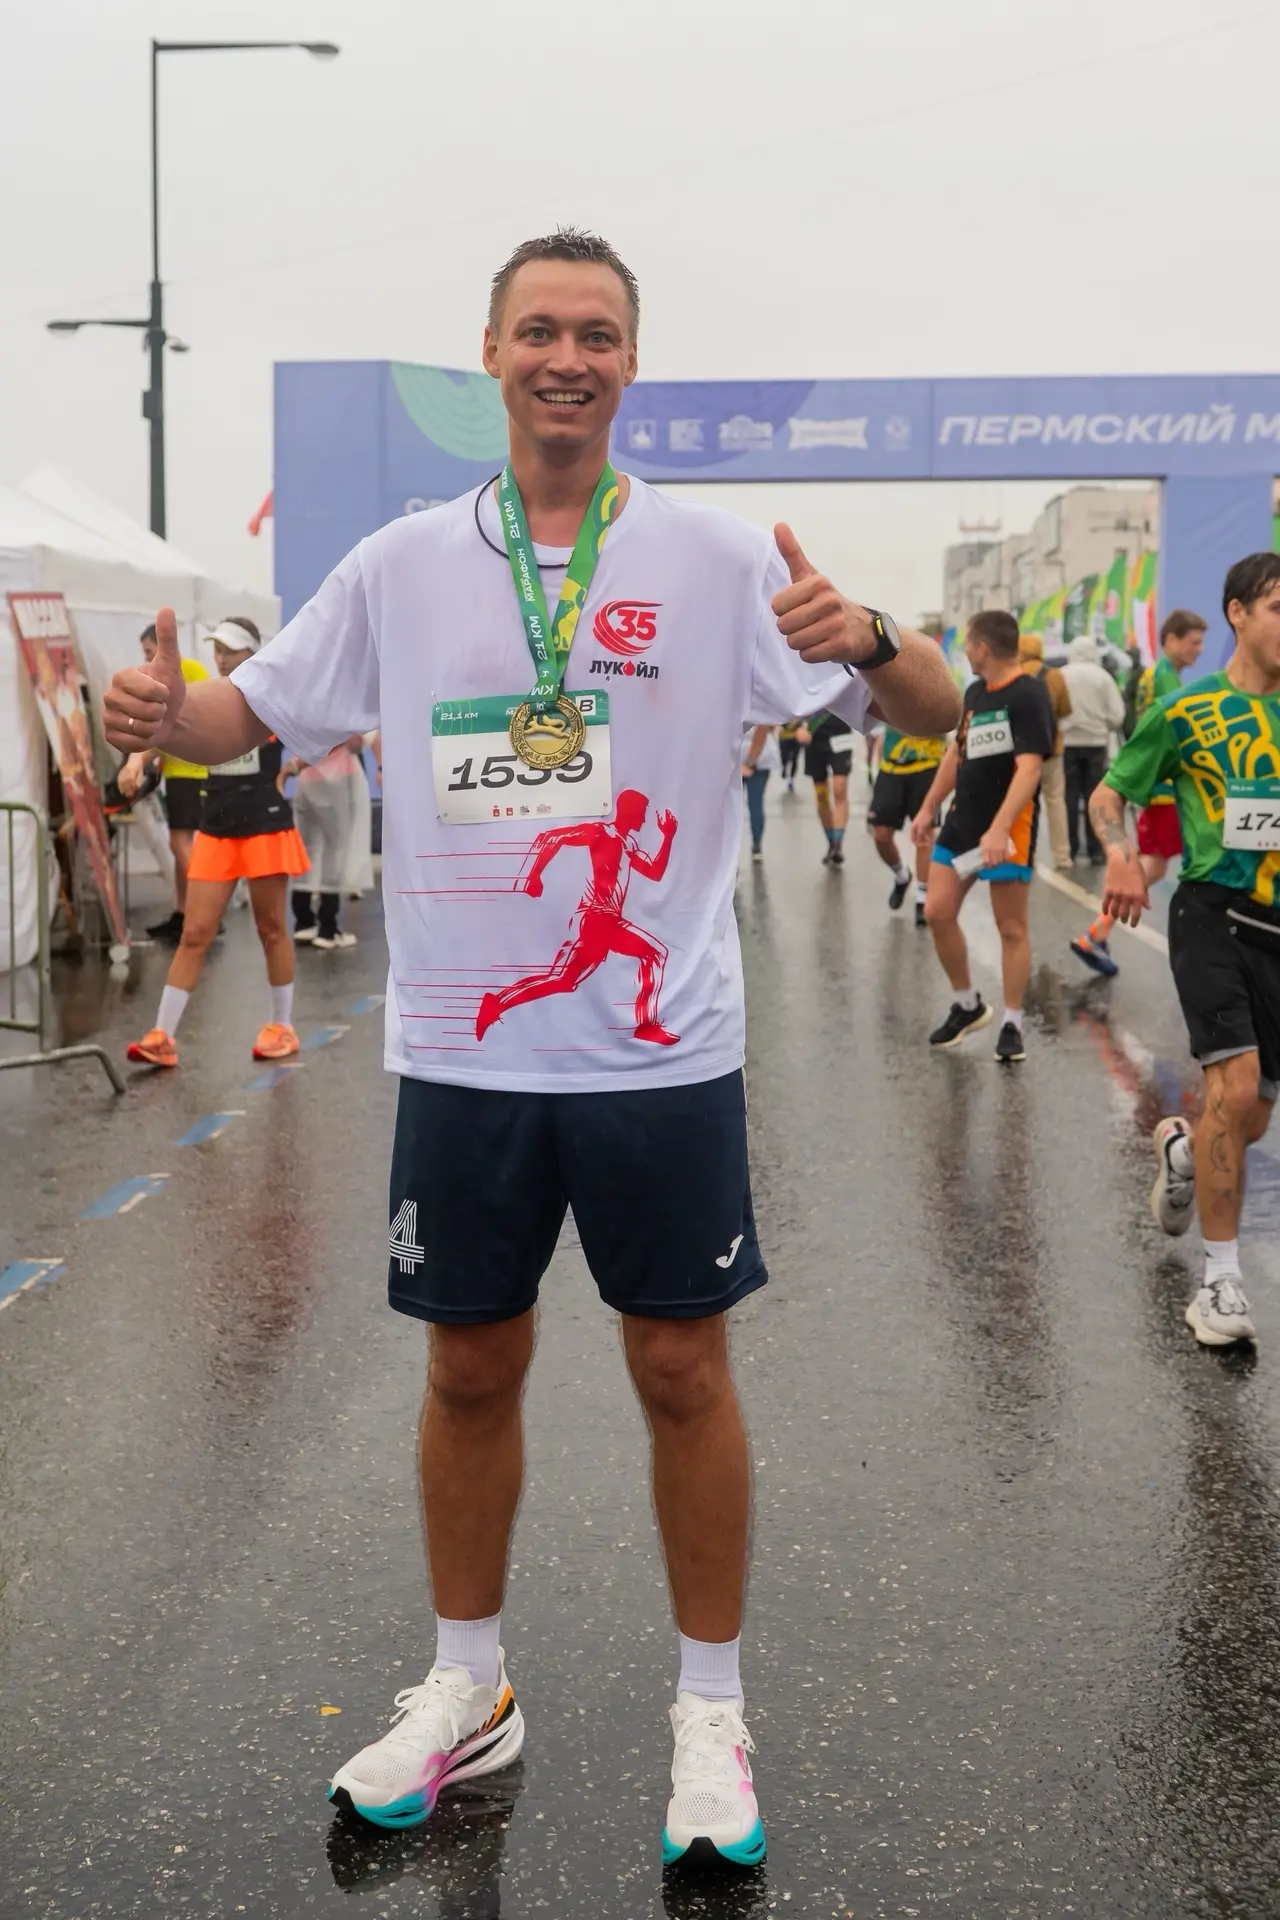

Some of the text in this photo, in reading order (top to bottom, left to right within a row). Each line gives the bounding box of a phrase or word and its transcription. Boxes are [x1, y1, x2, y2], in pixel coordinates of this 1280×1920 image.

[939, 404, 1237, 445] ПЕРМСКИЙ
[503, 500, 517, 521] КМ
[509, 522, 521, 539] 21
[517, 548, 535, 602] МАРАФОН
[529, 615, 543, 639] КМ
[615, 608, 657, 641] 35
[535, 641, 549, 661] 21
[440, 711, 462, 721] 21,1
